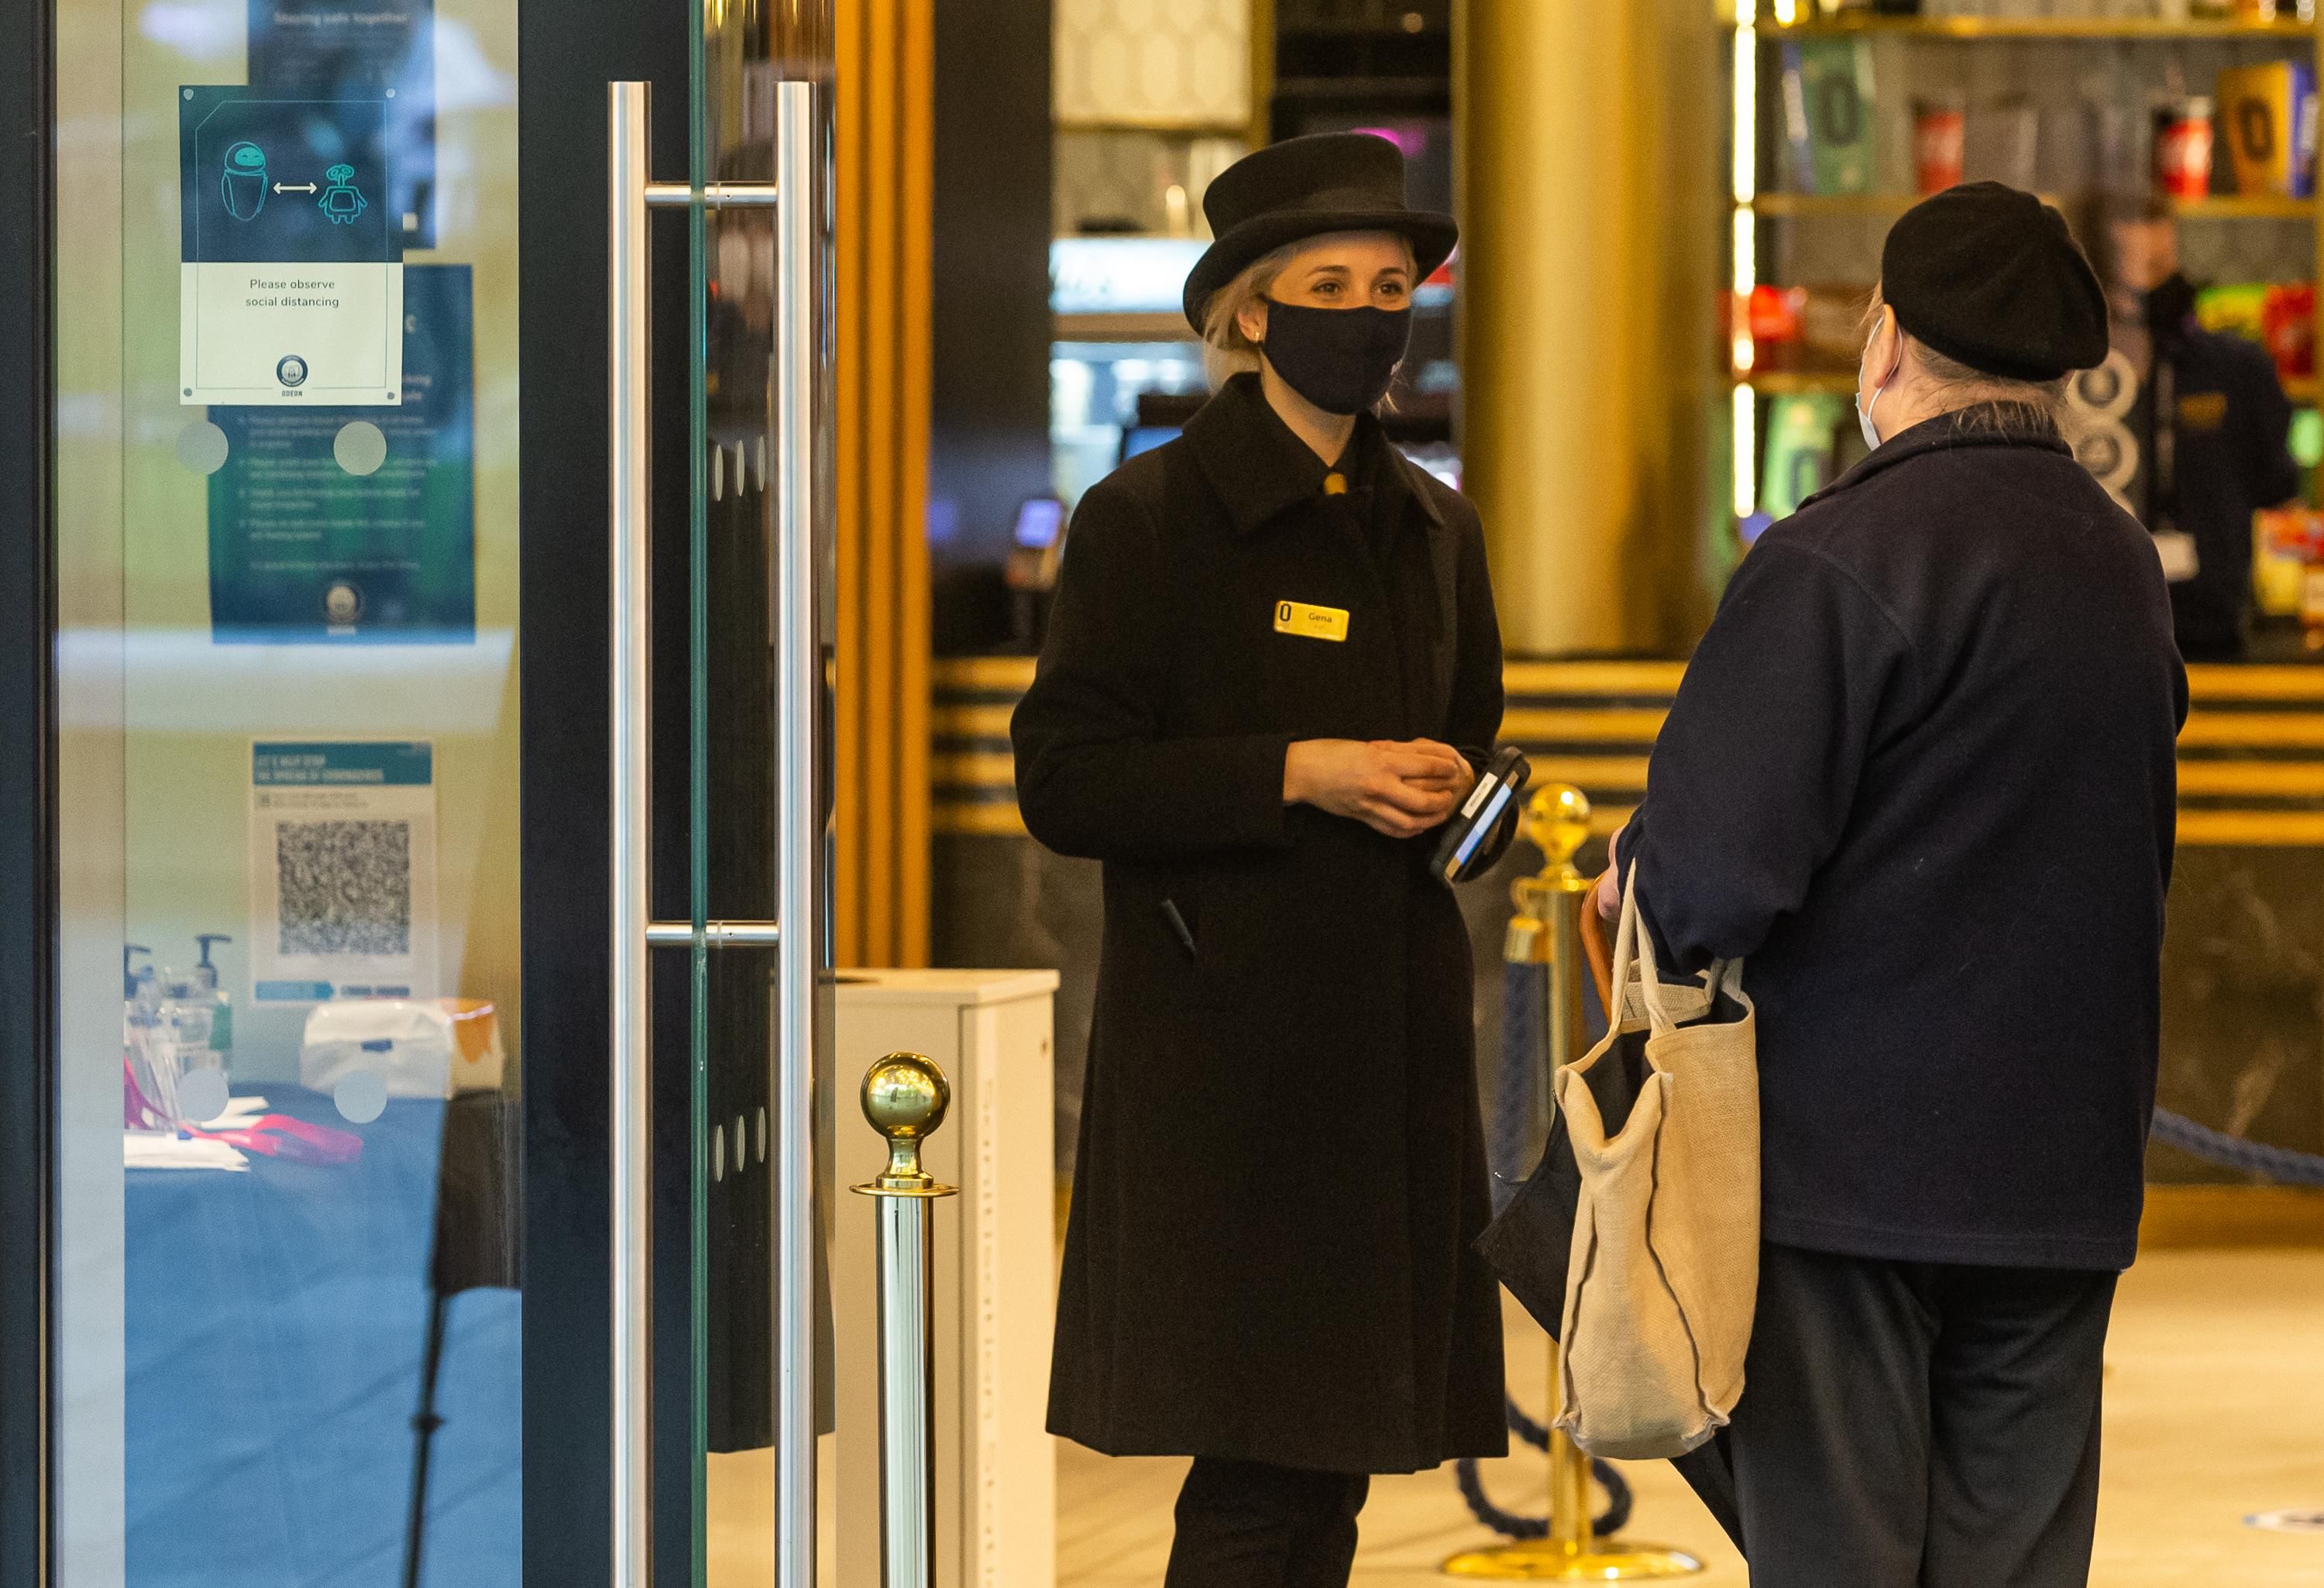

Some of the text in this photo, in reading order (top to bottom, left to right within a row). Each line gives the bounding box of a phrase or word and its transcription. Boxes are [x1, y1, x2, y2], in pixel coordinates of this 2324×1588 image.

[249, 279, 335, 289] Please observe
[246, 297, 339, 310] social distancing
[1308, 613, 1332, 623] Gena
